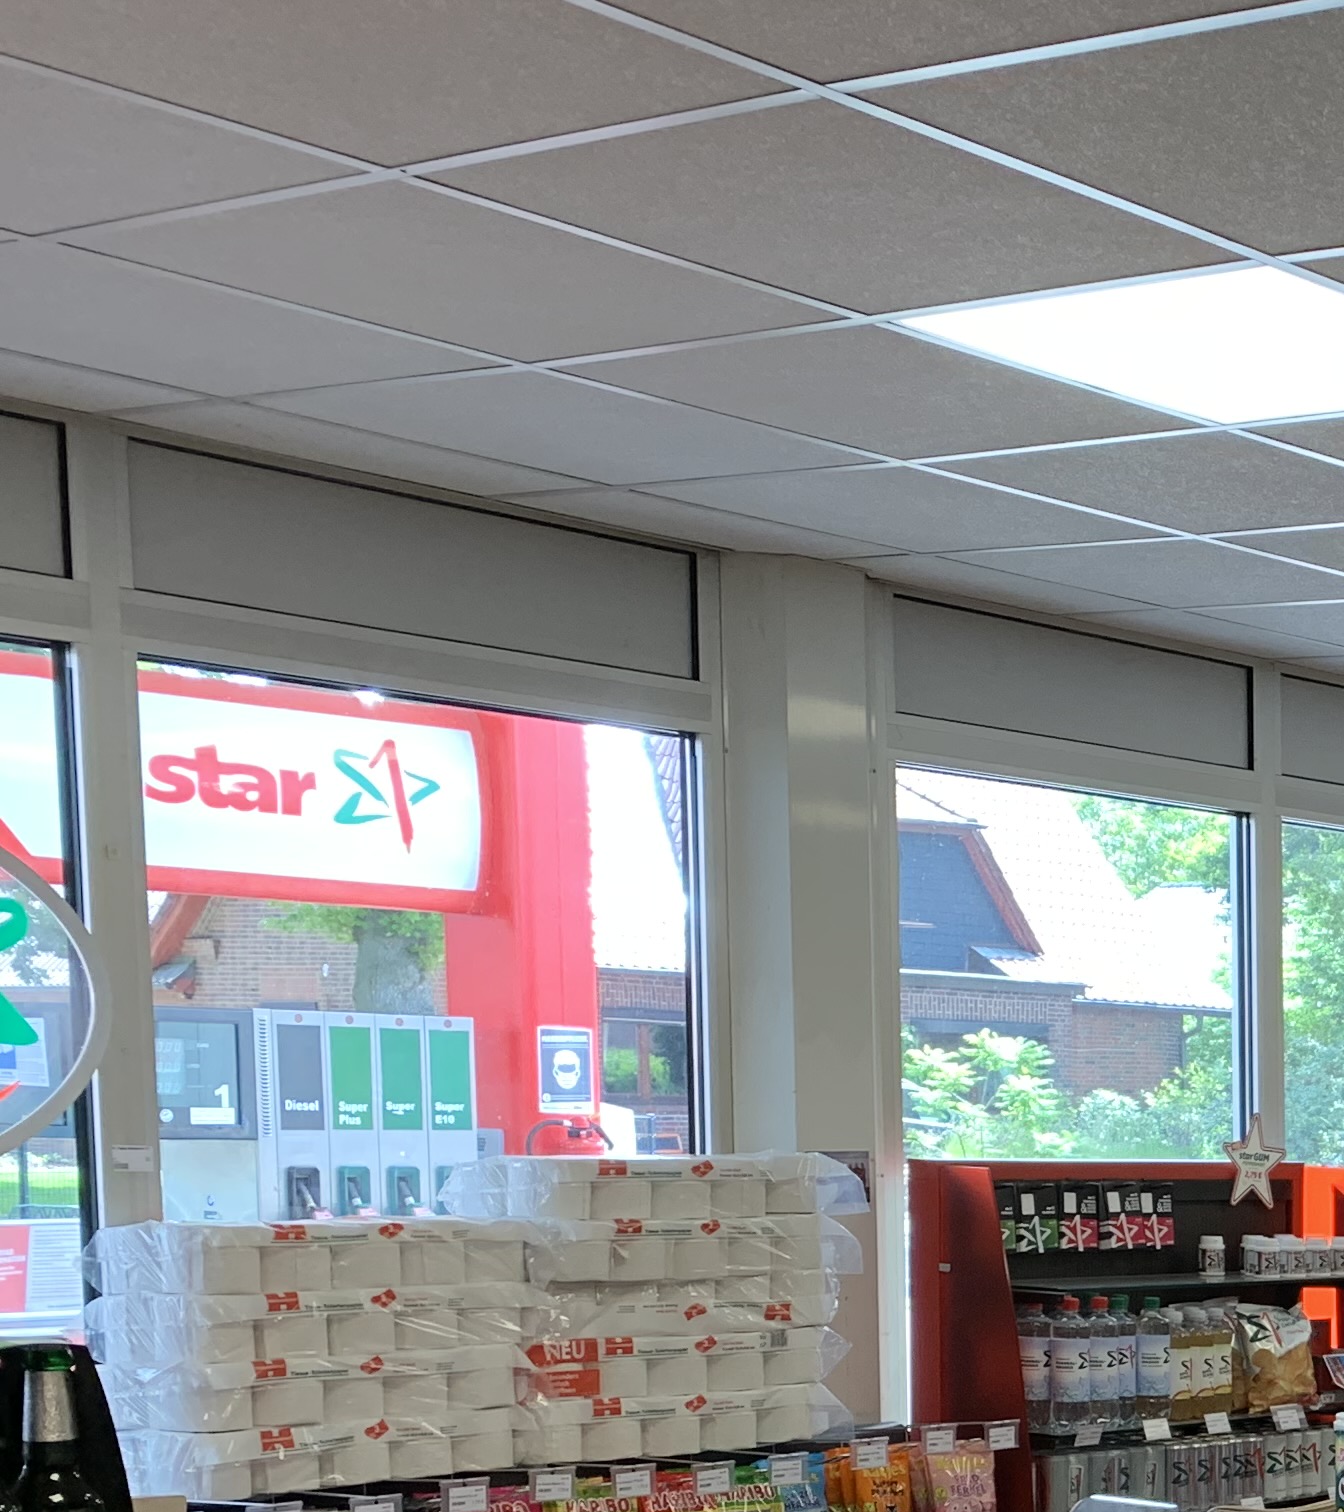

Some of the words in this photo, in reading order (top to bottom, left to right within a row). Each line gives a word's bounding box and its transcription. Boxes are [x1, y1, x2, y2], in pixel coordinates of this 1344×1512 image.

[145, 745, 316, 816] star
[214, 1084, 230, 1107] 1
[284, 1099, 319, 1112] Diesel
[338, 1101, 369, 1114] Super
[385, 1100, 416, 1112] Super
[435, 1101, 465, 1114] Super
[339, 1114, 362, 1126] Plus
[436, 1114, 455, 1124] E10
[542, 1339, 586, 1361] NEU
